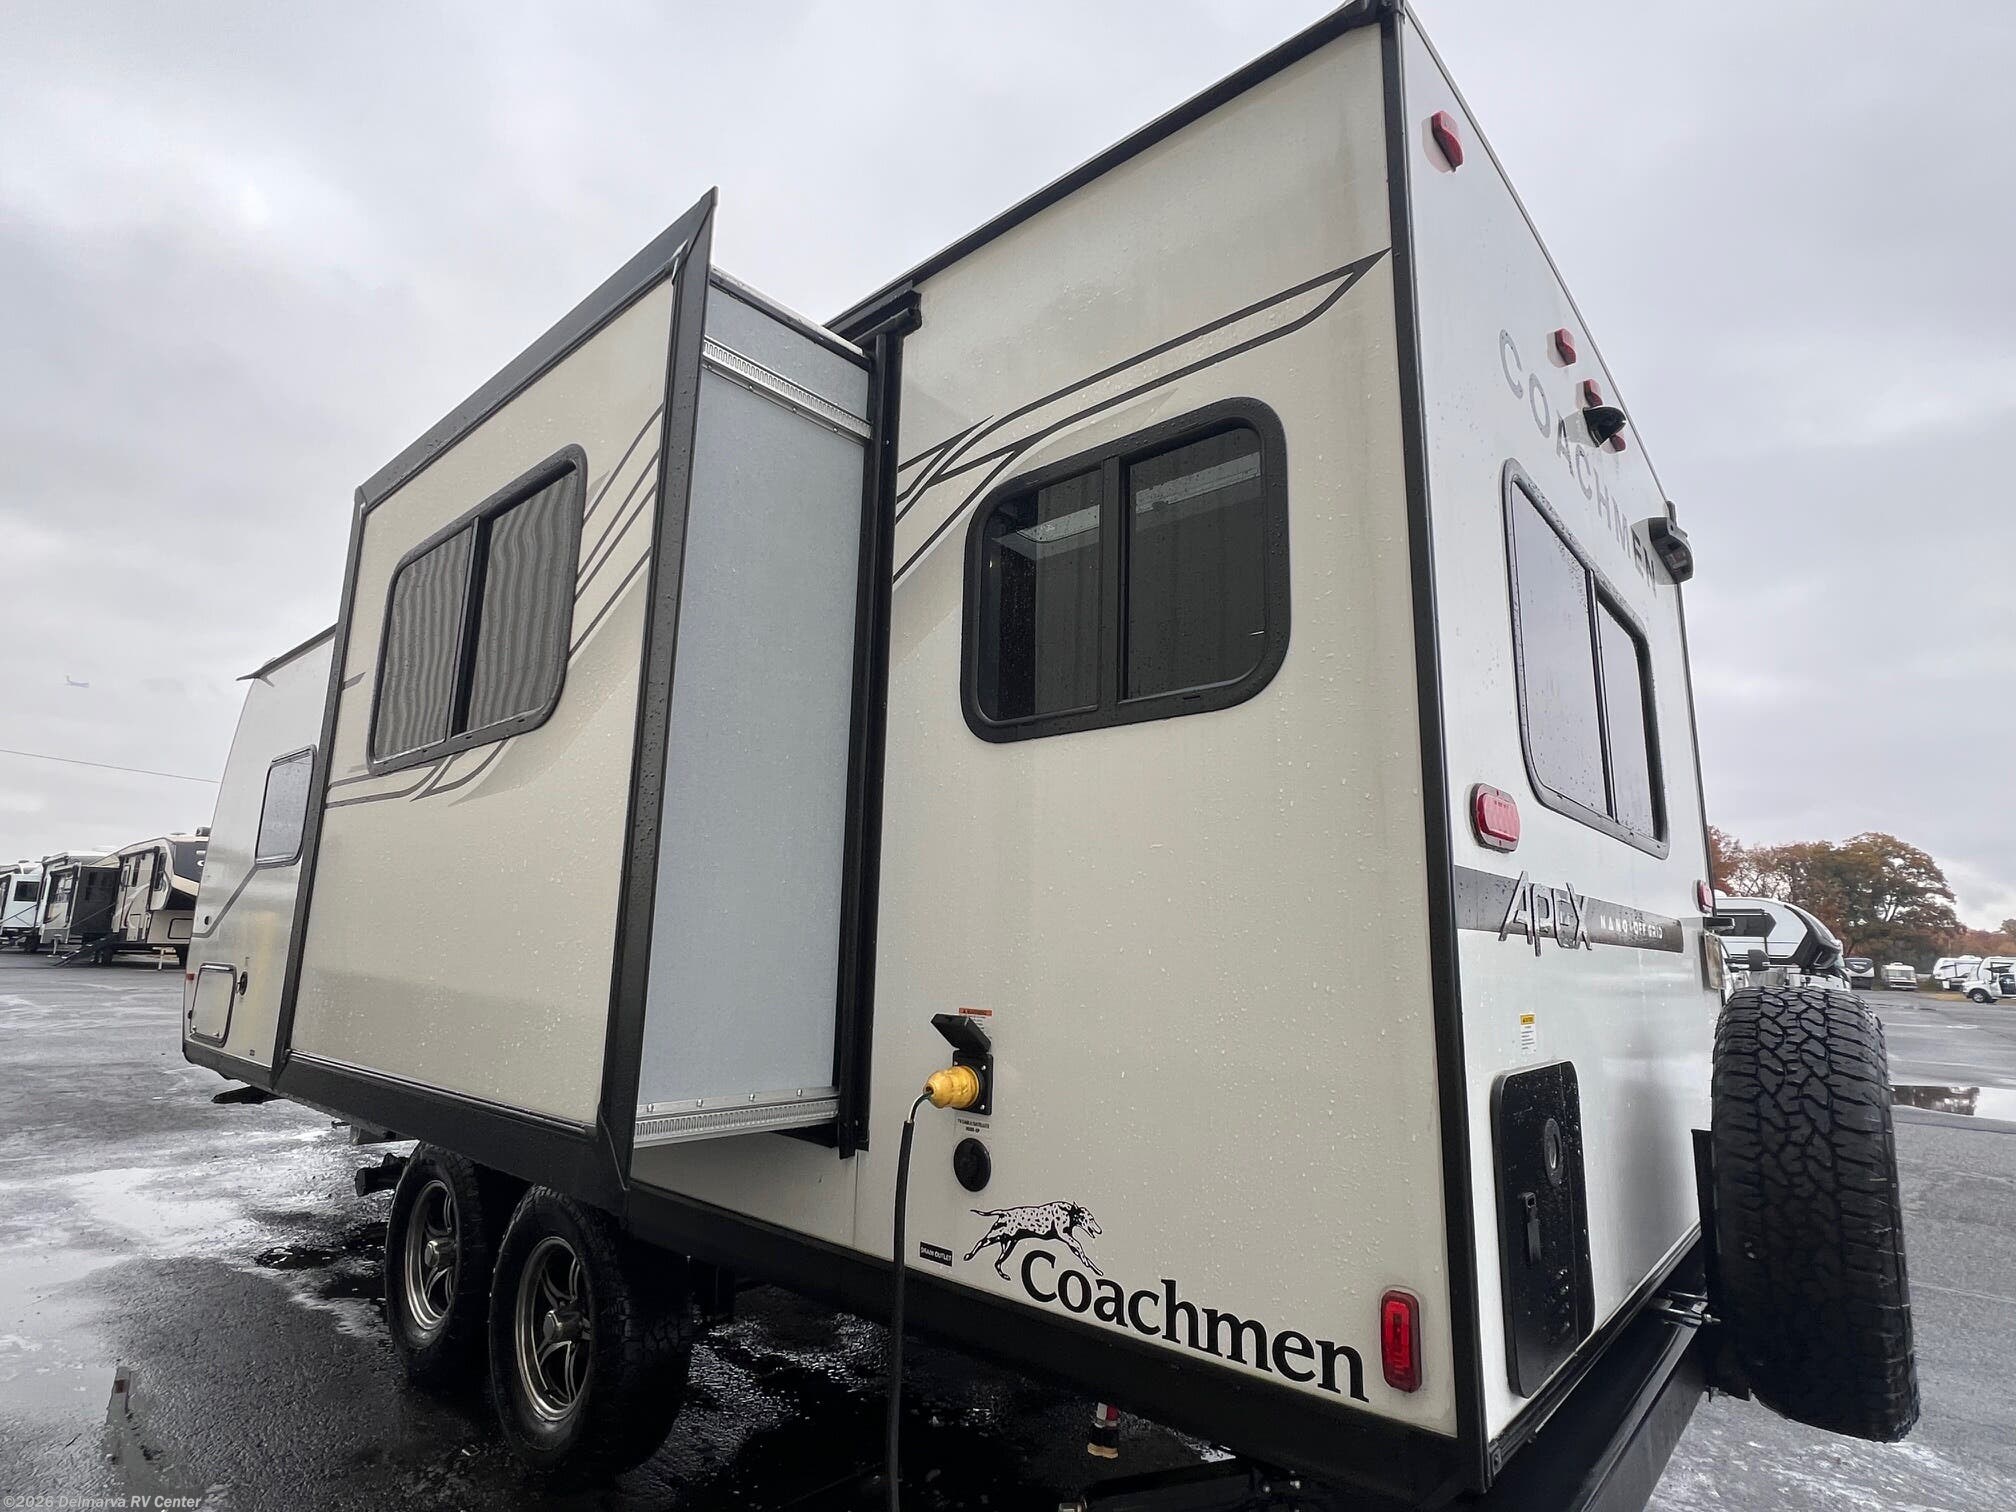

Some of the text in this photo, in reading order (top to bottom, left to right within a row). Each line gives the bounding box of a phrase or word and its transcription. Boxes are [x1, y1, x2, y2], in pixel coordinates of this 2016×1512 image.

[1498, 871, 1592, 957] APEX
[1600, 914, 1628, 934] NANO
[1020, 1249, 1370, 1403] Coachmen
